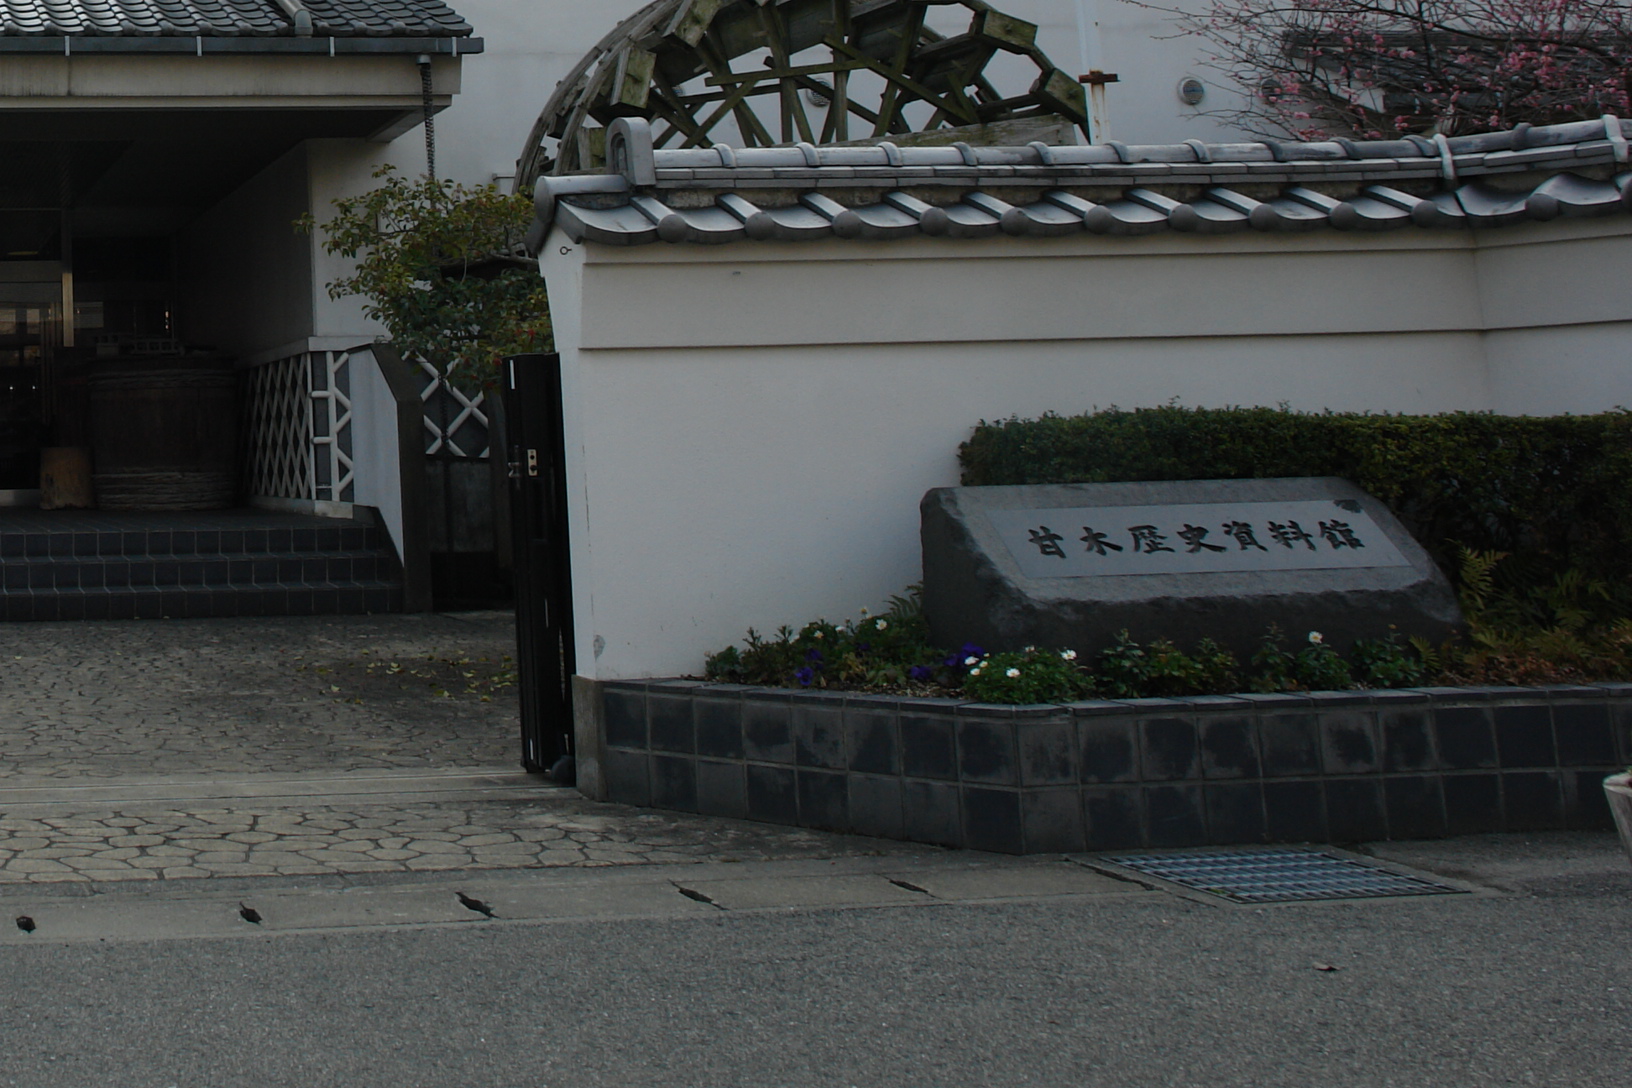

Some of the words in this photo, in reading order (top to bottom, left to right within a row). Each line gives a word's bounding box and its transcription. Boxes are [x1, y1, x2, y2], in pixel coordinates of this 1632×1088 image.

[1027, 519, 1366, 560] 甘木歴史資料館
